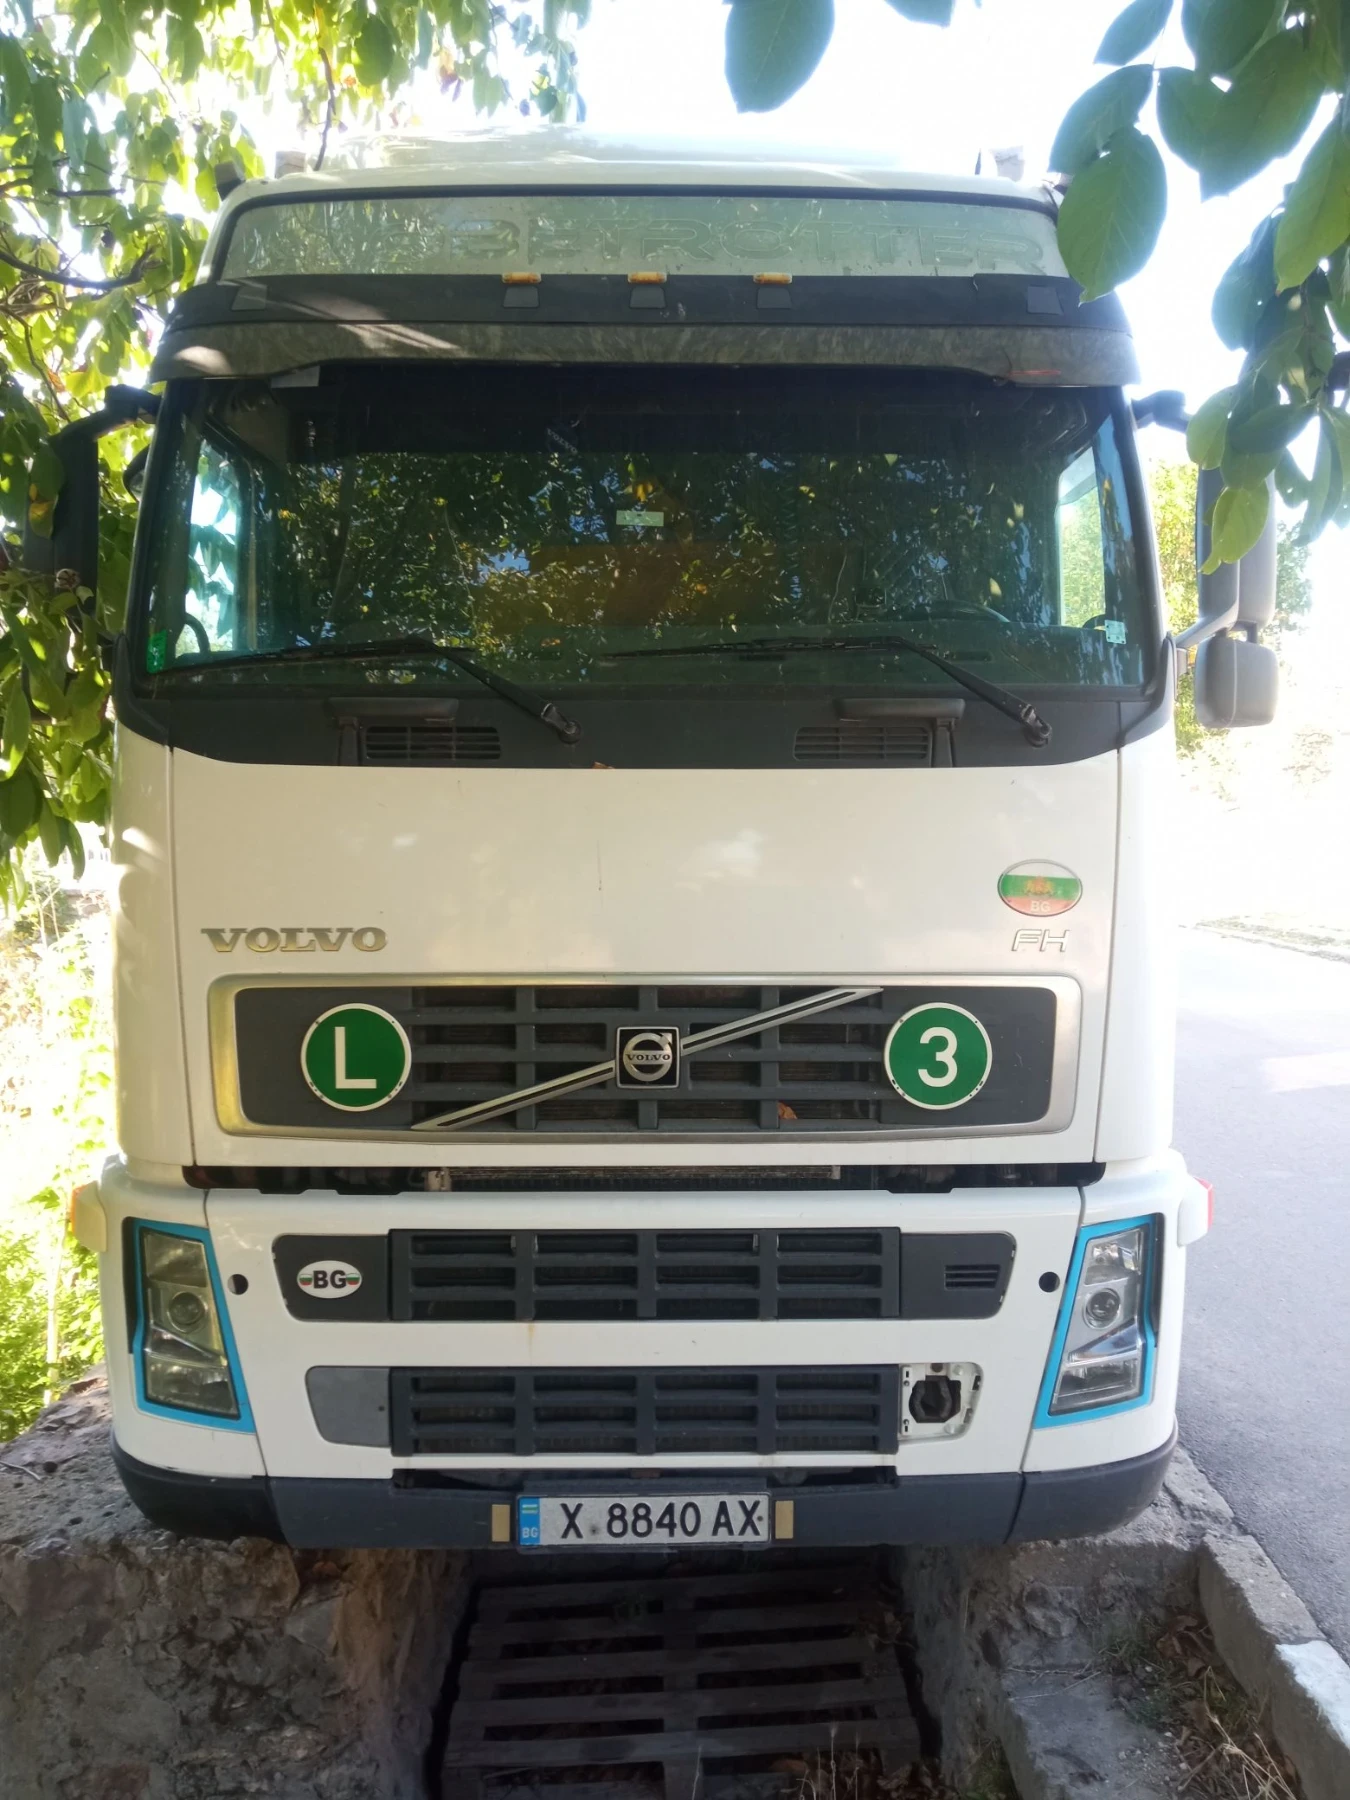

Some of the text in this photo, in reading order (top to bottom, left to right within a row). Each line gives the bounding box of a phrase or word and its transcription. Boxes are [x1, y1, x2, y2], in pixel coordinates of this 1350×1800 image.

[1030, 900, 1051, 912] BG
[200, 926, 388, 952] VOLVO
[1011, 928, 1071, 952] FH
[334, 1026, 377, 1089] L
[625, 1053, 671, 1061] VOLVO
[917, 1026, 958, 1088] 3
[313, 1269, 347, 1290] BG
[560, 1500, 761, 1539] X 8840 AX
[522, 1527, 538, 1538] BG
